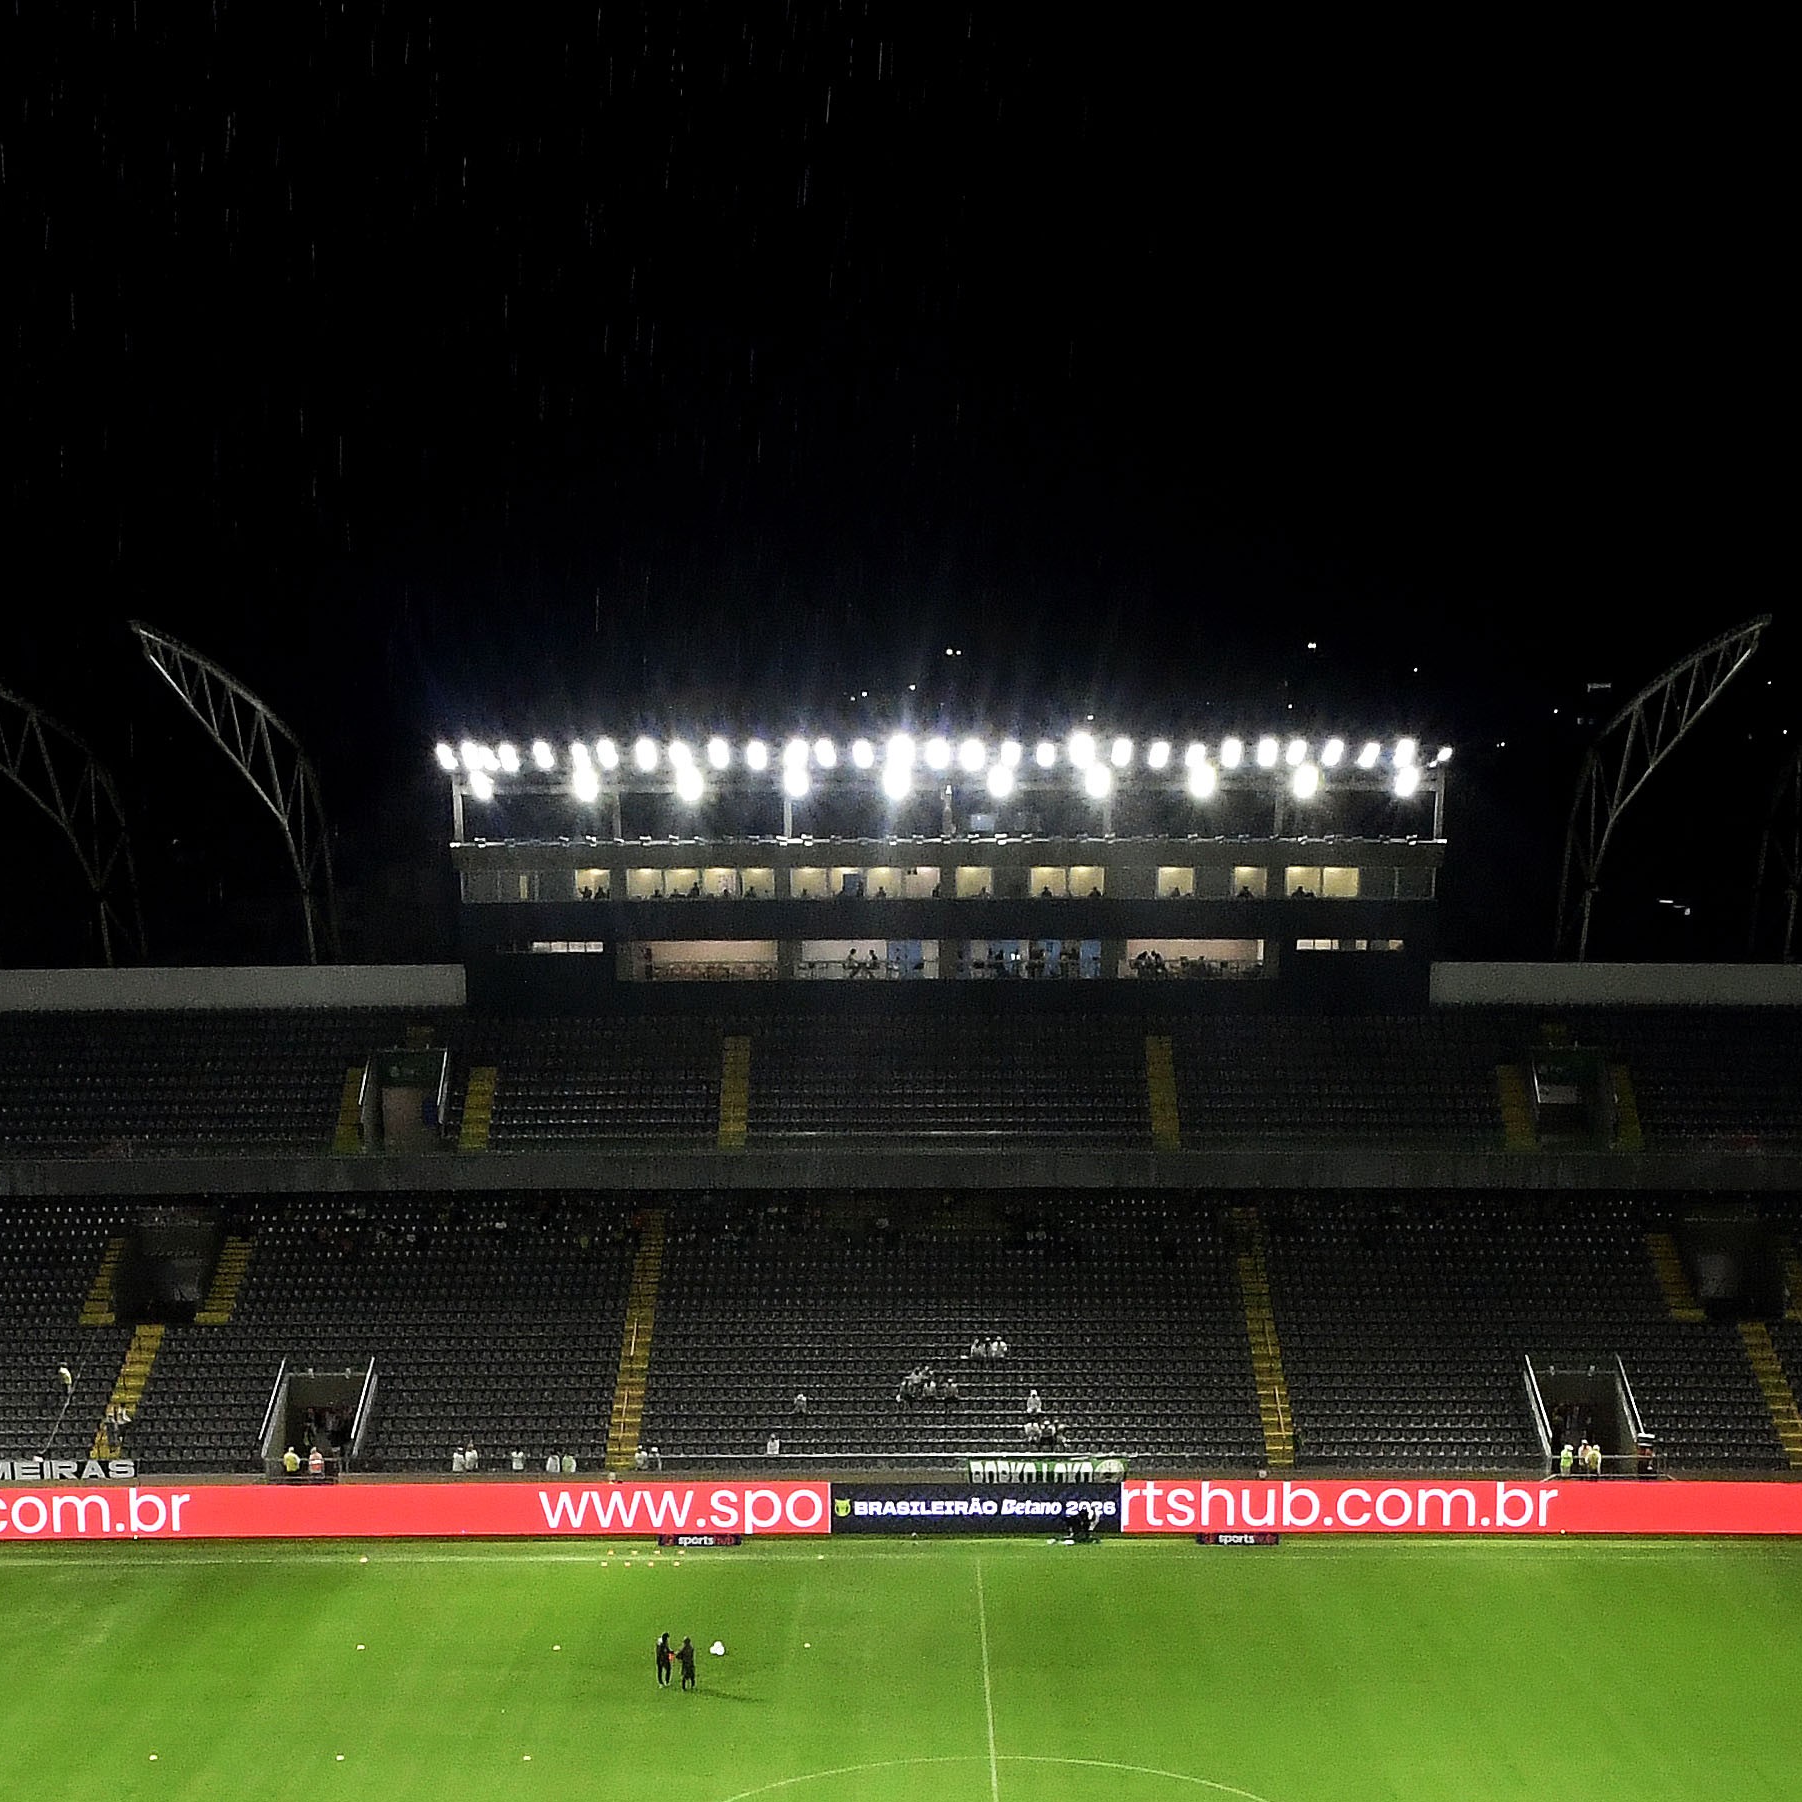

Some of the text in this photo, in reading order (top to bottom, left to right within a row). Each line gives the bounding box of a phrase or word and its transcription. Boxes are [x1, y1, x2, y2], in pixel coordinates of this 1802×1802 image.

[539, 1489, 823, 1535] www.spo
[854, 1498, 997, 1516] BRASILEIRÃO
[1001, 1499, 1061, 1516] Betano
[1122, 1480, 1559, 1528] rtshub.com.br
